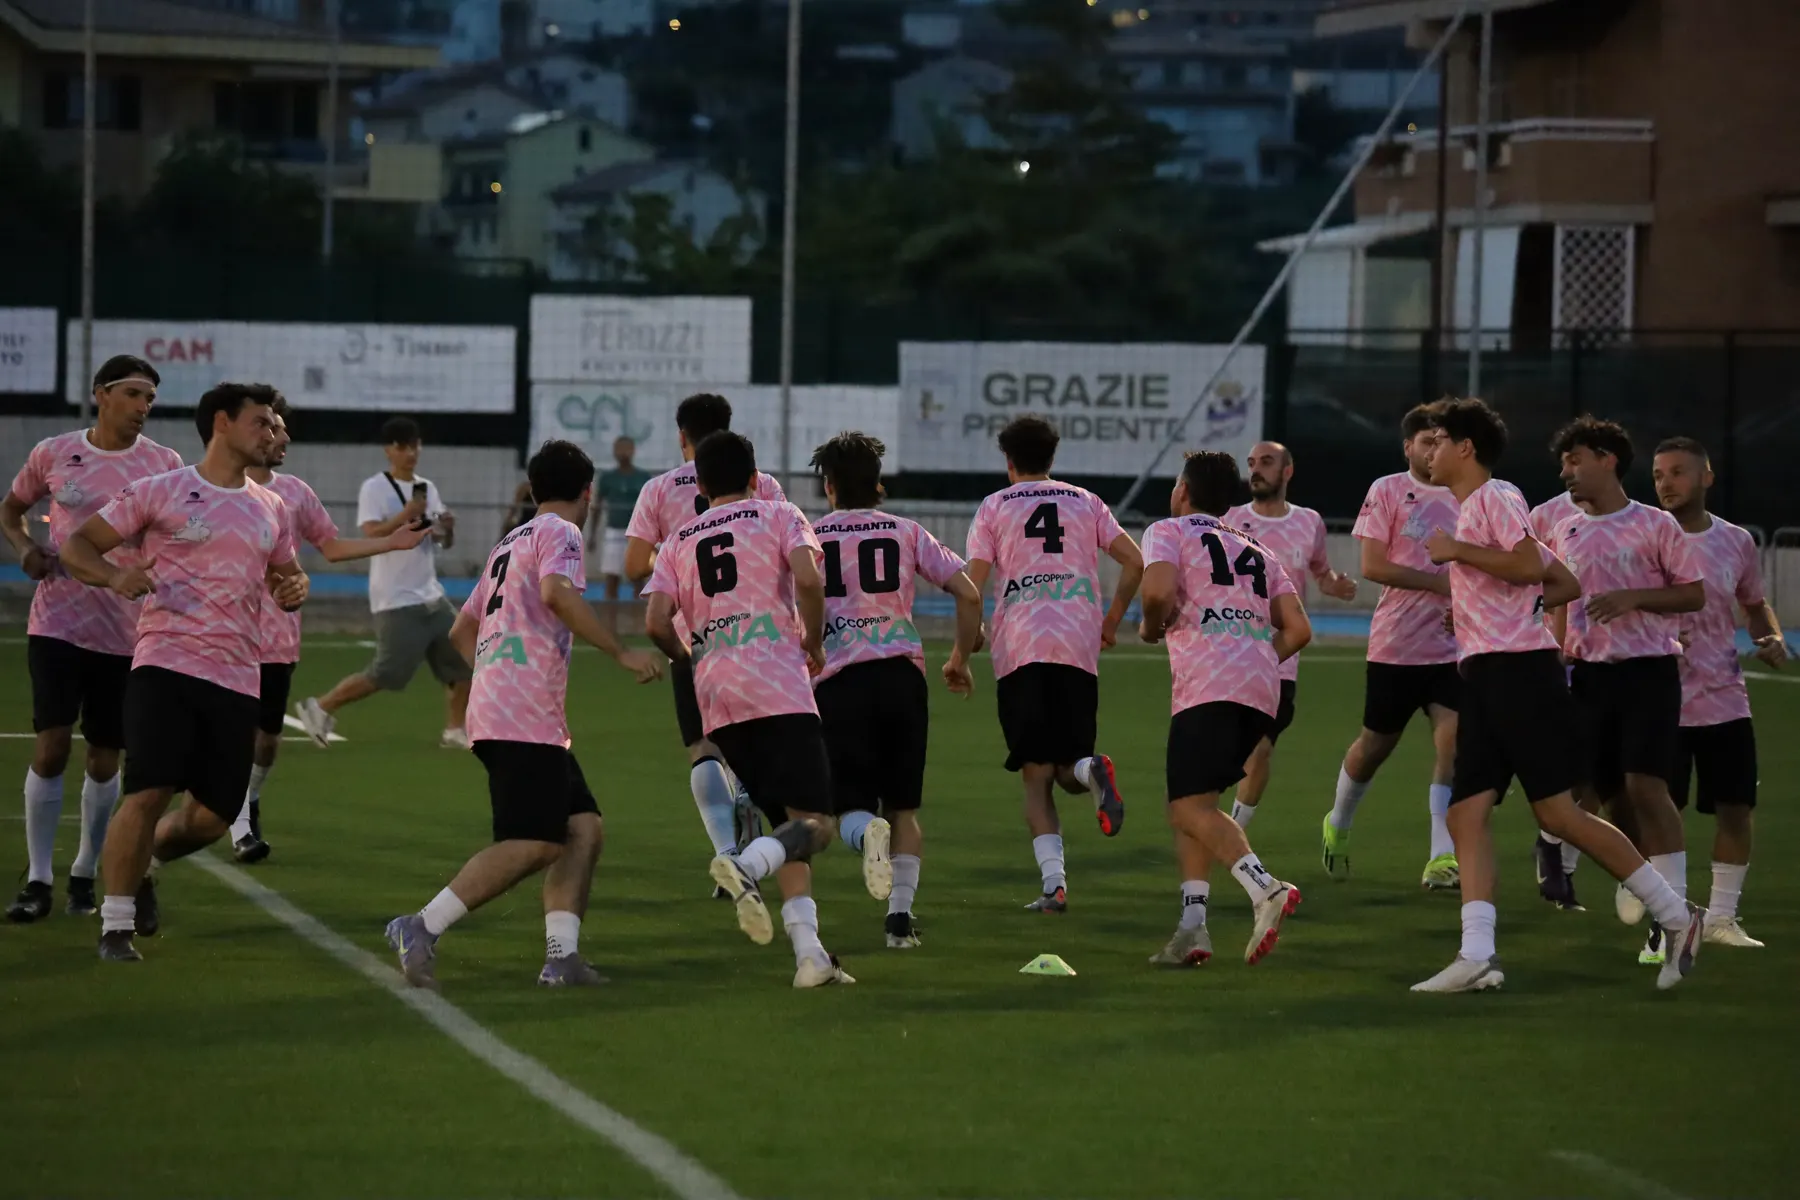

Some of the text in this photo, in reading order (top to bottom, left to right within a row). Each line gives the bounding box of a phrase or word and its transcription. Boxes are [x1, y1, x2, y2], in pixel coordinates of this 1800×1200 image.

[144, 337, 214, 364] CAM
[983, 372, 1170, 409] GRAZIE
[962, 412, 1187, 441] PRIDENTE
[1002, 489, 1080, 501] SCALASANTA
[679, 510, 759, 541] SCALASANTA
[814, 521, 897, 535] SCALASANTA
[1024, 502, 1065, 554] 4
[1189, 518, 1259, 546] SCALASANTA
[695, 531, 738, 598] 6
[821, 538, 900, 598] 10
[1200, 532, 1268, 599] 14
[485, 550, 512, 617] 2
